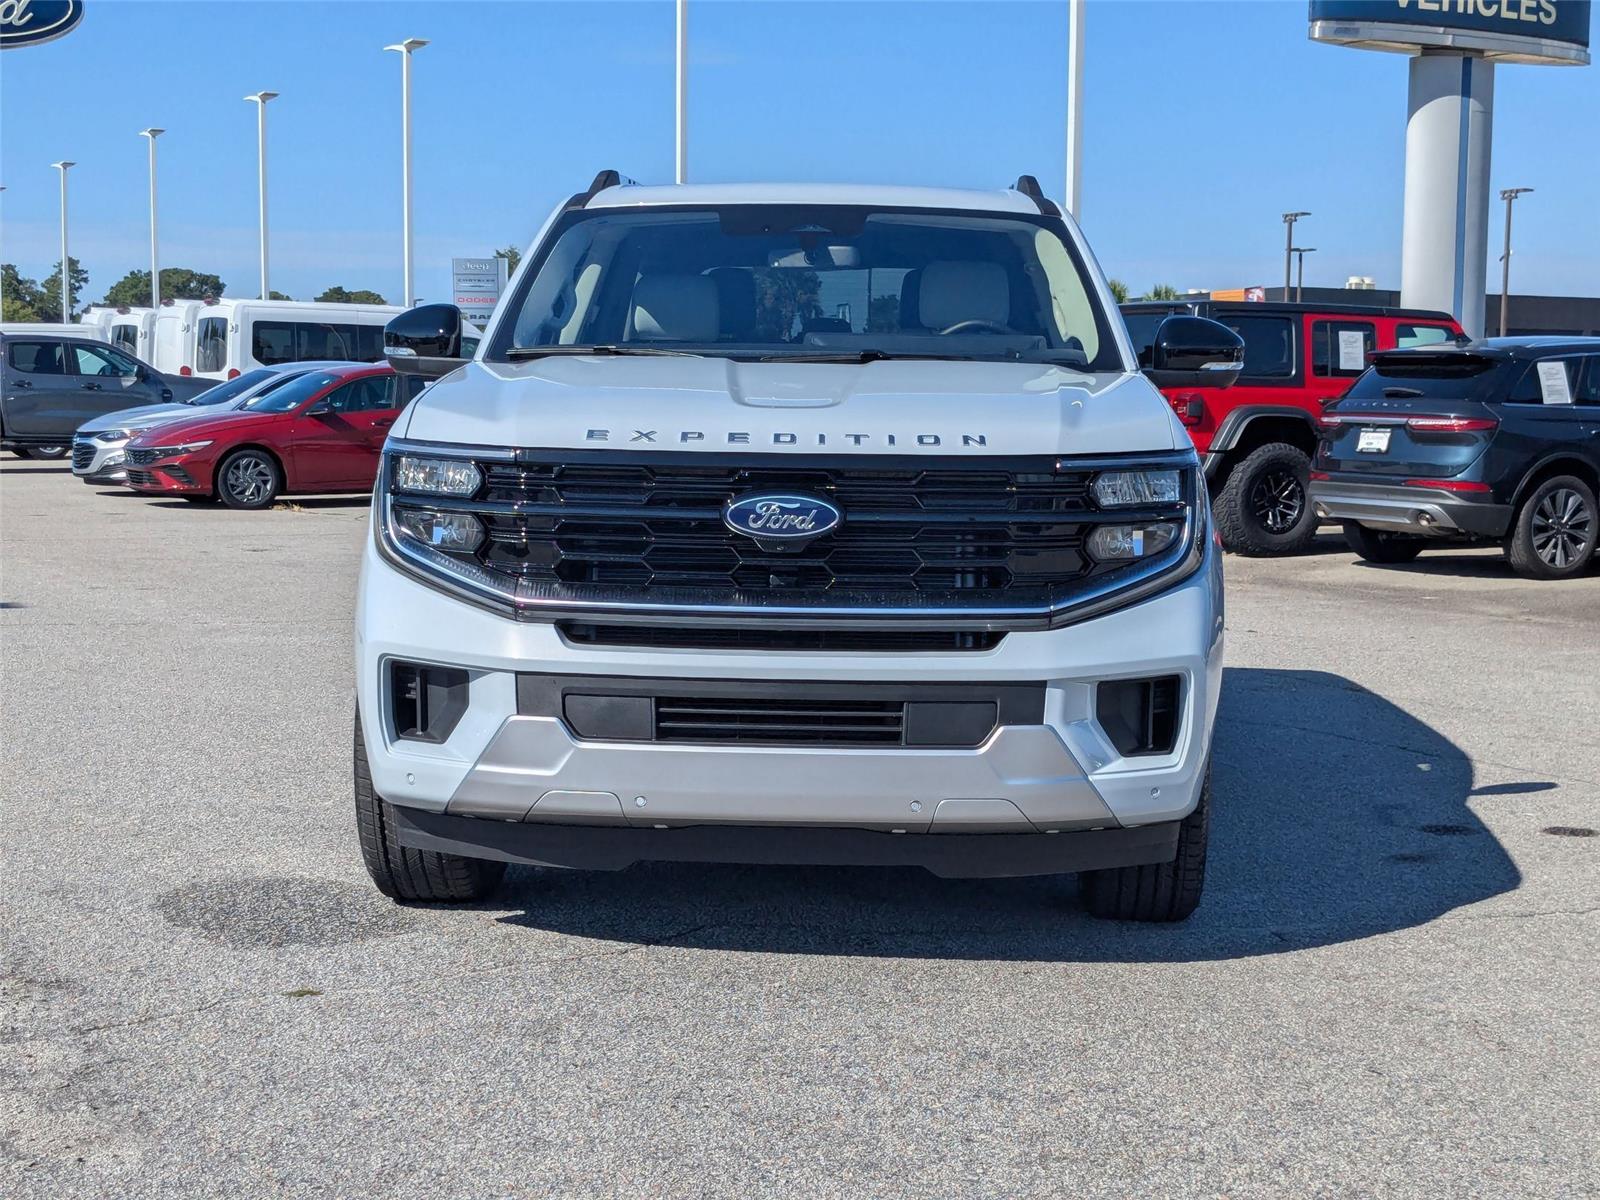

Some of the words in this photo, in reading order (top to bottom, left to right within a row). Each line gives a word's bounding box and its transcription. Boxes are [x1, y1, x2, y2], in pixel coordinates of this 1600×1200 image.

[1397, 0, 1557, 25] CLES
[463, 262, 489, 271] Jeep
[585, 428, 987, 447] EXPEDITION
[748, 501, 818, 530] Ford
